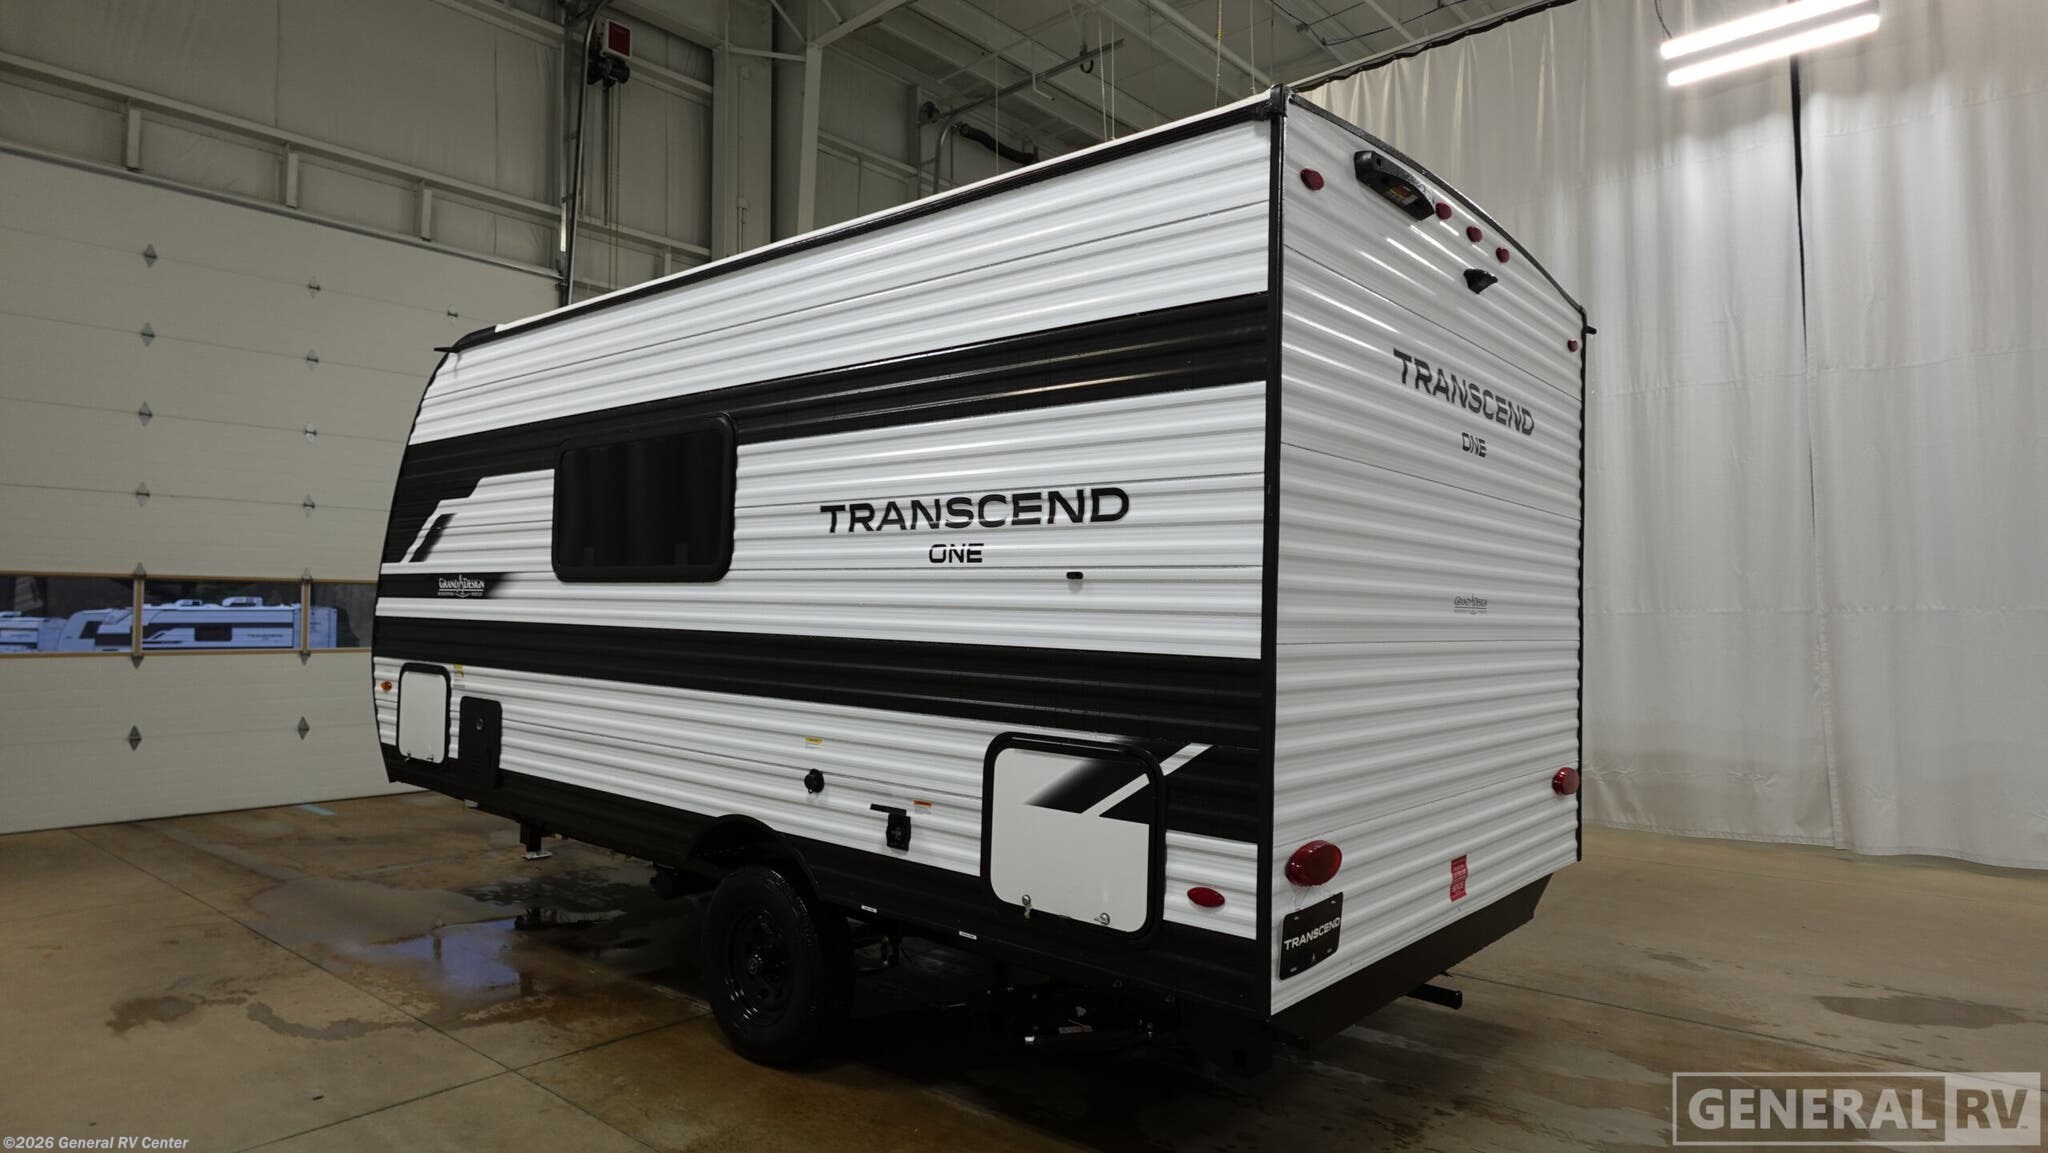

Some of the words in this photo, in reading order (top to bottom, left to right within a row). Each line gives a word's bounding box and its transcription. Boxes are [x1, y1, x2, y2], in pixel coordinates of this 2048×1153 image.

[1393, 348, 1535, 436] TRANSCEND
[1461, 432, 1487, 458] ONE
[820, 487, 1130, 533] TRANSCEND
[928, 543, 984, 564] ONE
[1284, 917, 1341, 950] TRANSCEND
